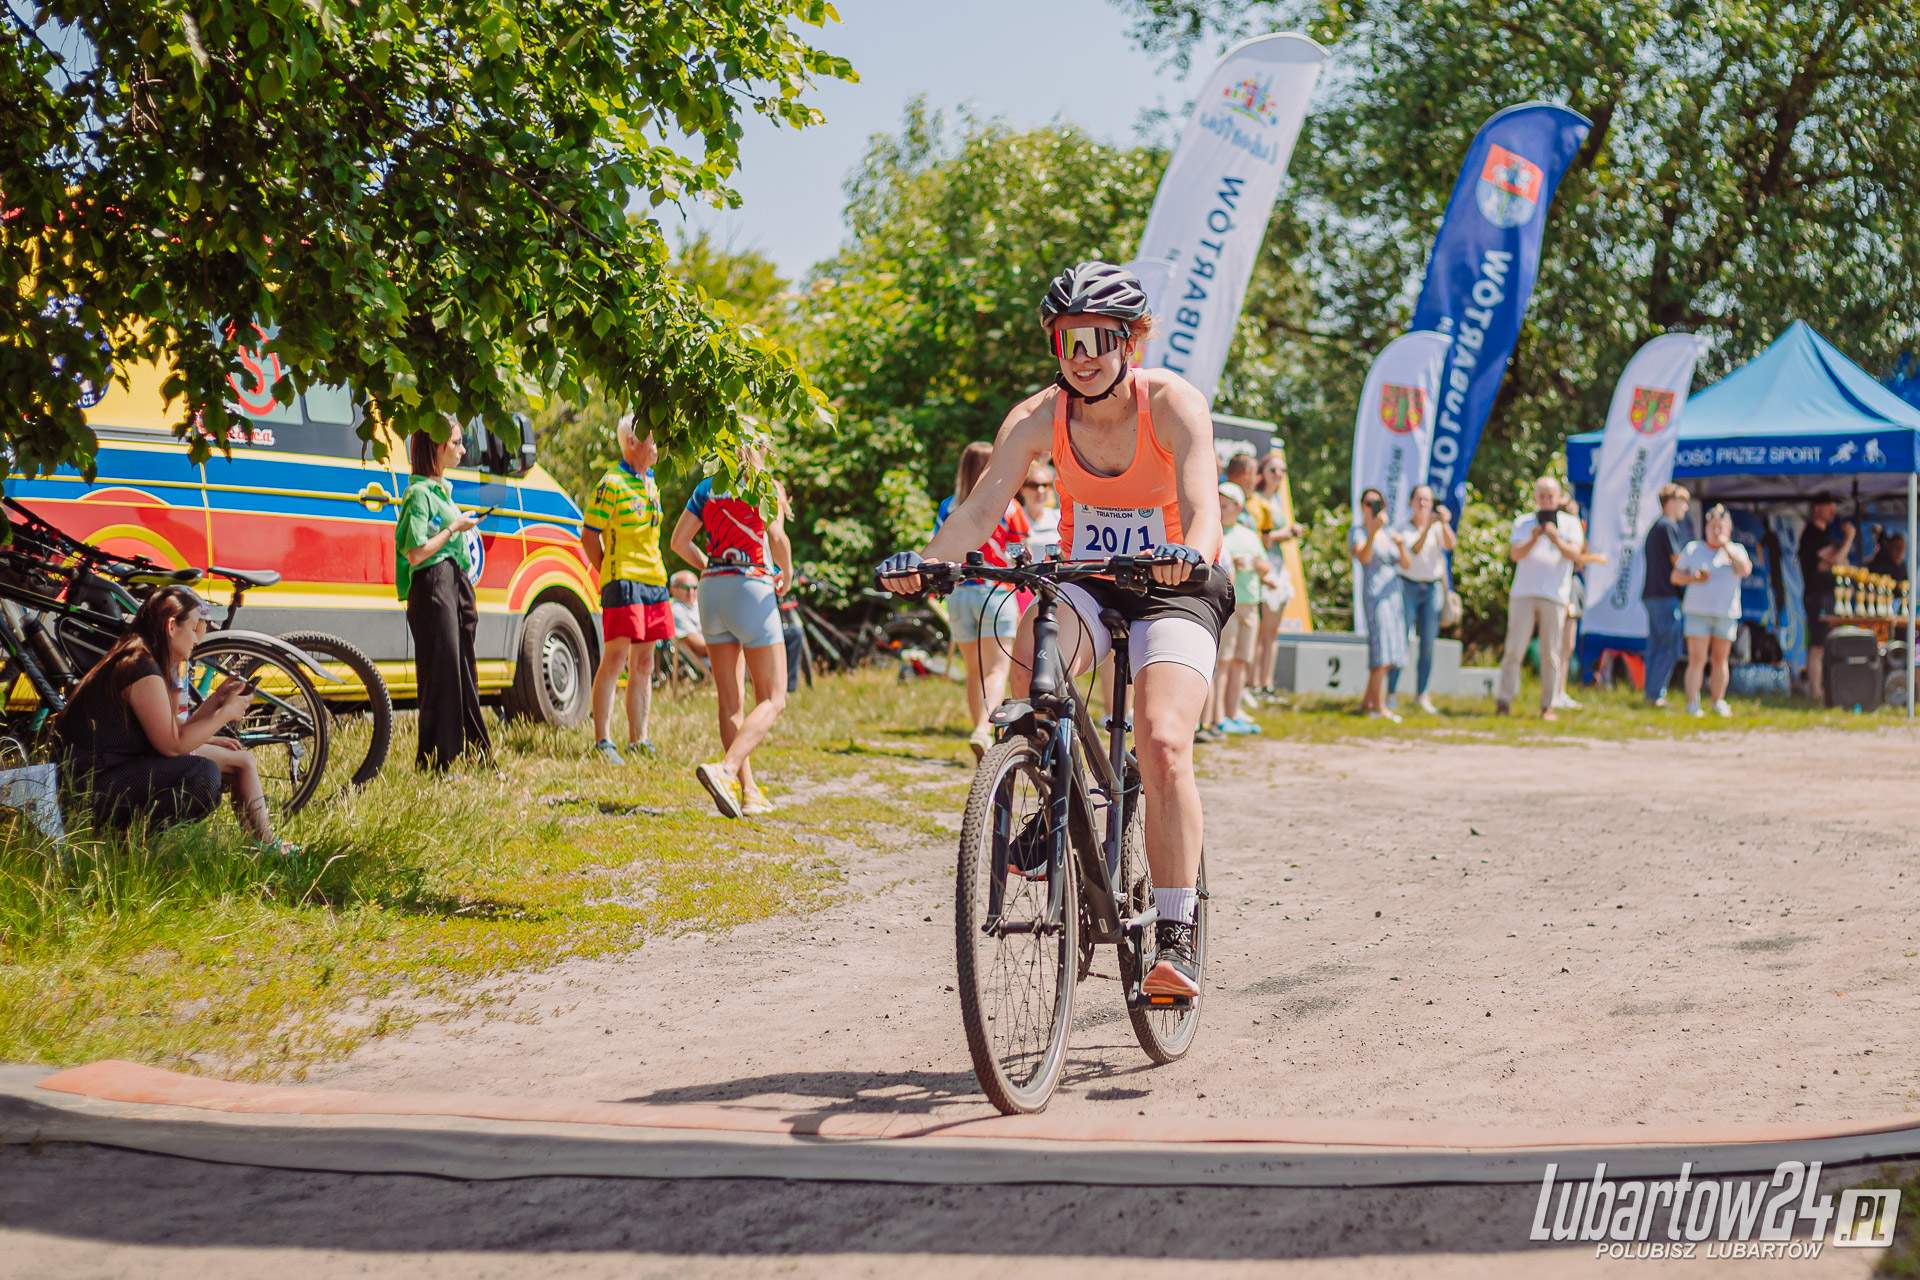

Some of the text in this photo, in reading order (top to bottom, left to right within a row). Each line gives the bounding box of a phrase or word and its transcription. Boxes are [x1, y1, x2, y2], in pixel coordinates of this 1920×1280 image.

[1768, 446, 1820, 464] SPORT
[1095, 510, 1133, 519] TRIATHLON
[1326, 655, 1341, 688] 2
